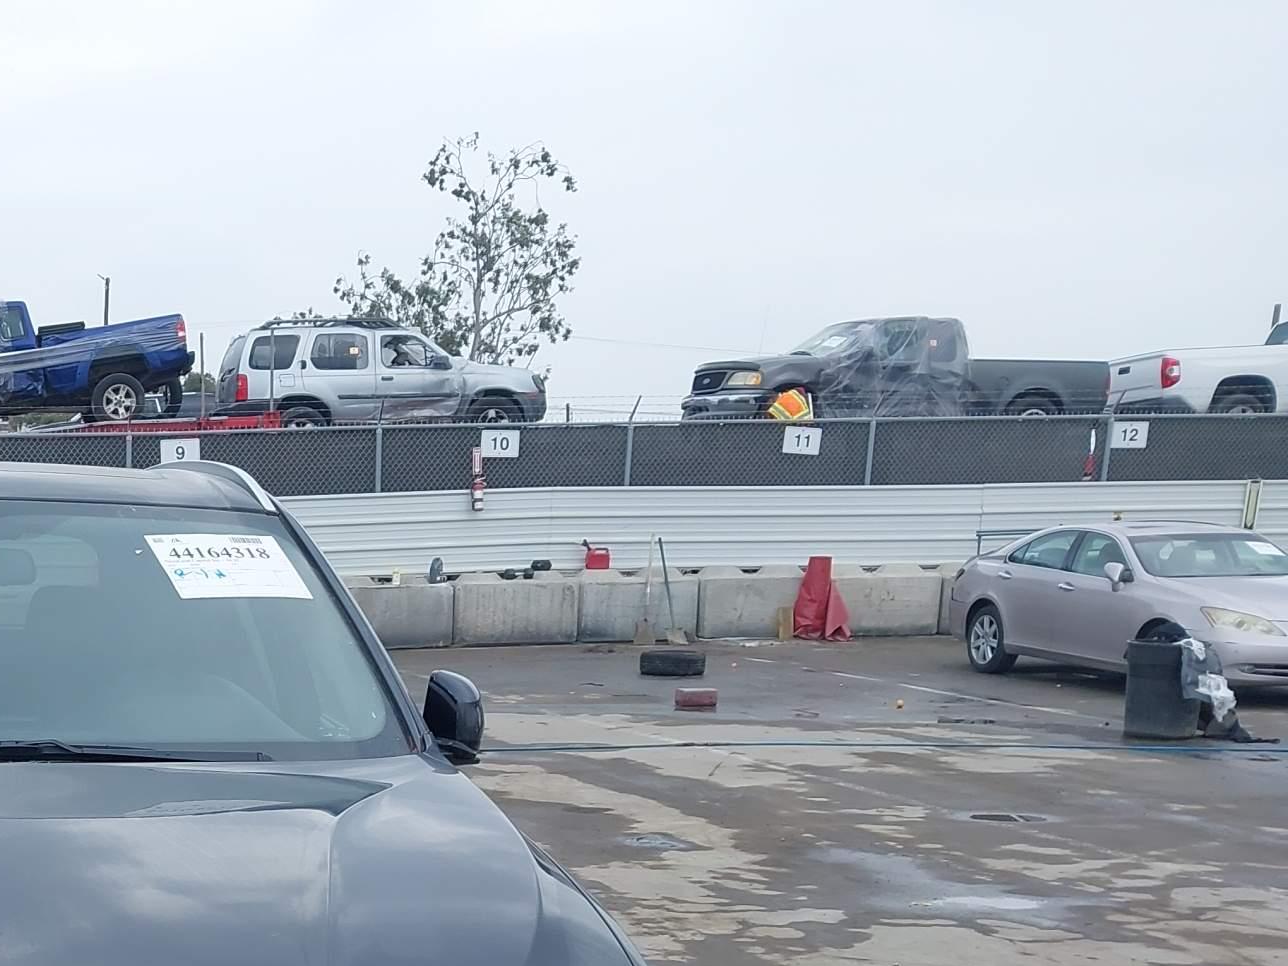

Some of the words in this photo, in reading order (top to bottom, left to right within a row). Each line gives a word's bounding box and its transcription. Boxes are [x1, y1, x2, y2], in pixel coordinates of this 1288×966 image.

[794, 434, 811, 448] 11
[1121, 428, 1139, 442] 12
[491, 436, 510, 451] 10
[175, 445, 185, 460] 9
[169, 546, 271, 560] 44164318
